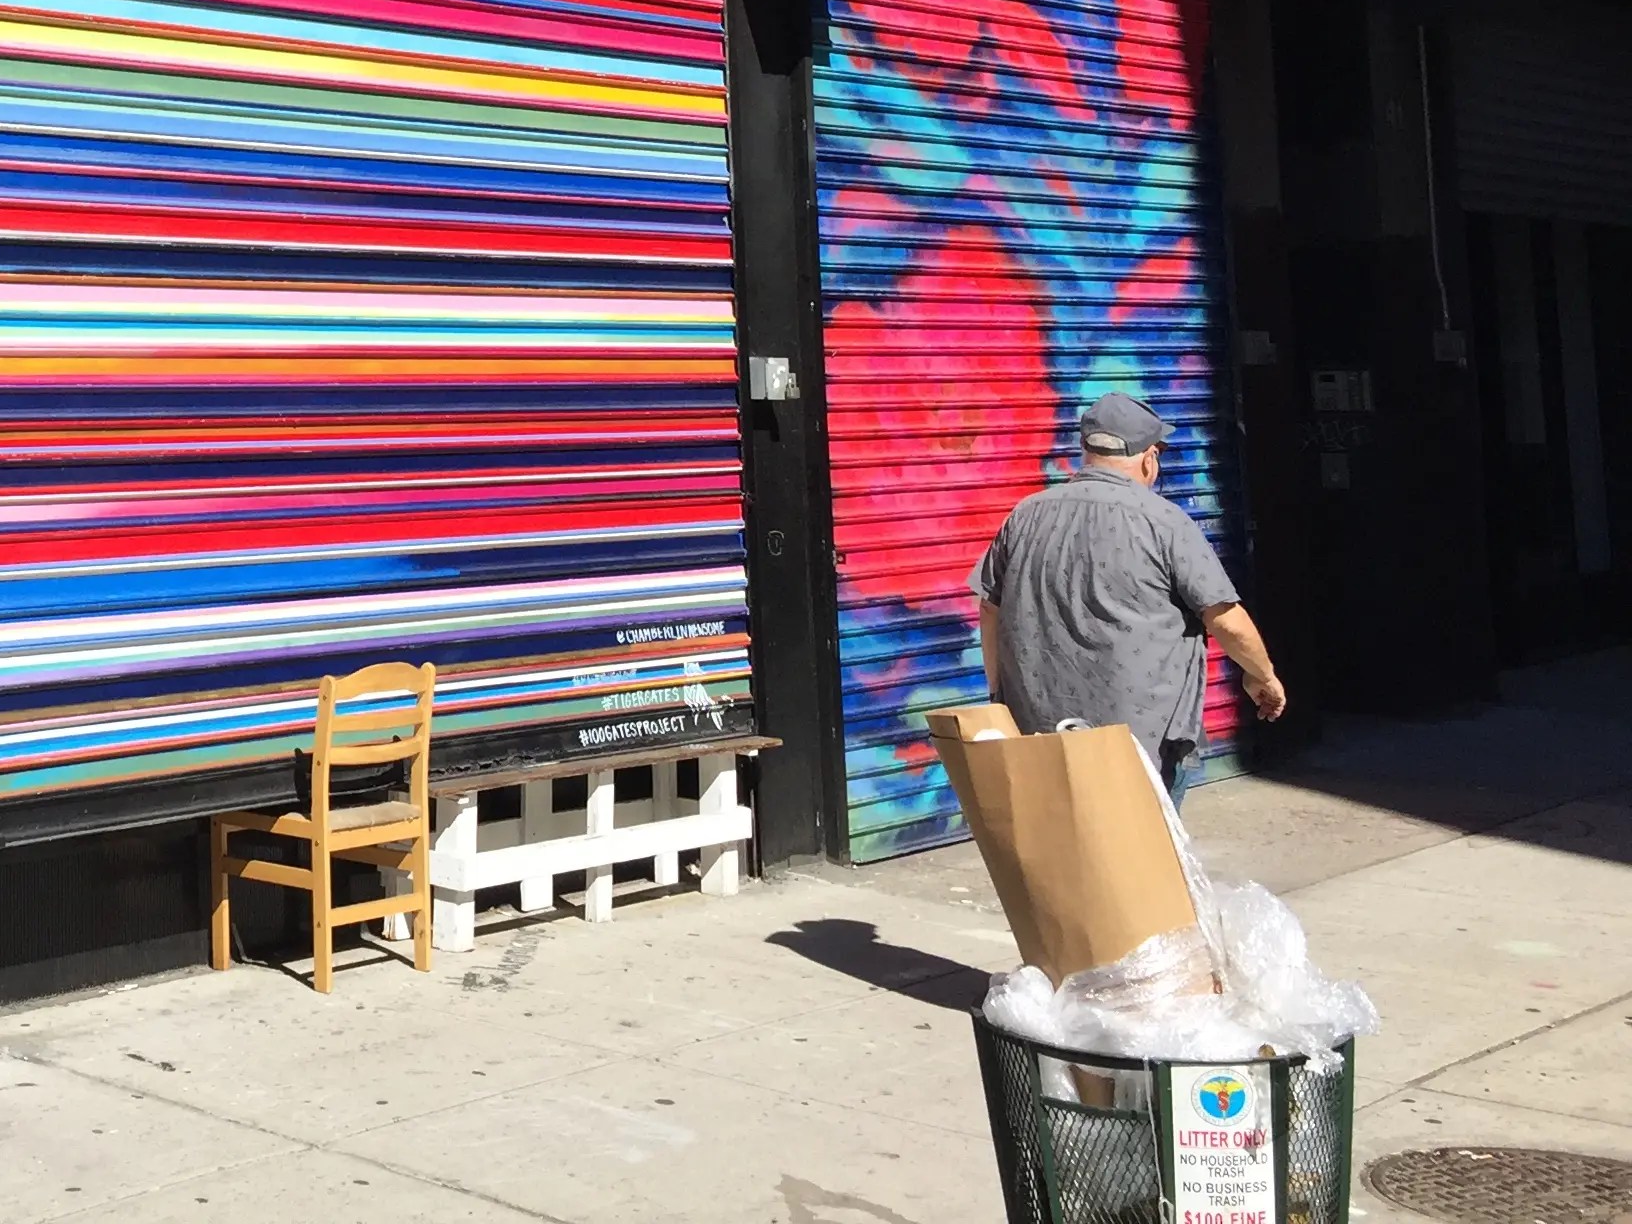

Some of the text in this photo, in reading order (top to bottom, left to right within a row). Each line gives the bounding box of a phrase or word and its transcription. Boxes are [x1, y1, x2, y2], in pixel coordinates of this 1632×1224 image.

[601, 687, 679, 711] #TIGERGATES
[578, 715, 686, 747] #100GATESPROJECT
[1179, 1128, 1267, 1147] LITTER ONLY
[1180, 1153, 1268, 1166] NO HOUSEHOLD
[1208, 1167, 1245, 1178] TRASH
[1183, 1181, 1267, 1194] NO BUSINESS
[1209, 1195, 1245, 1206] TRASH
[1184, 1210, 1223, 1224] $100
